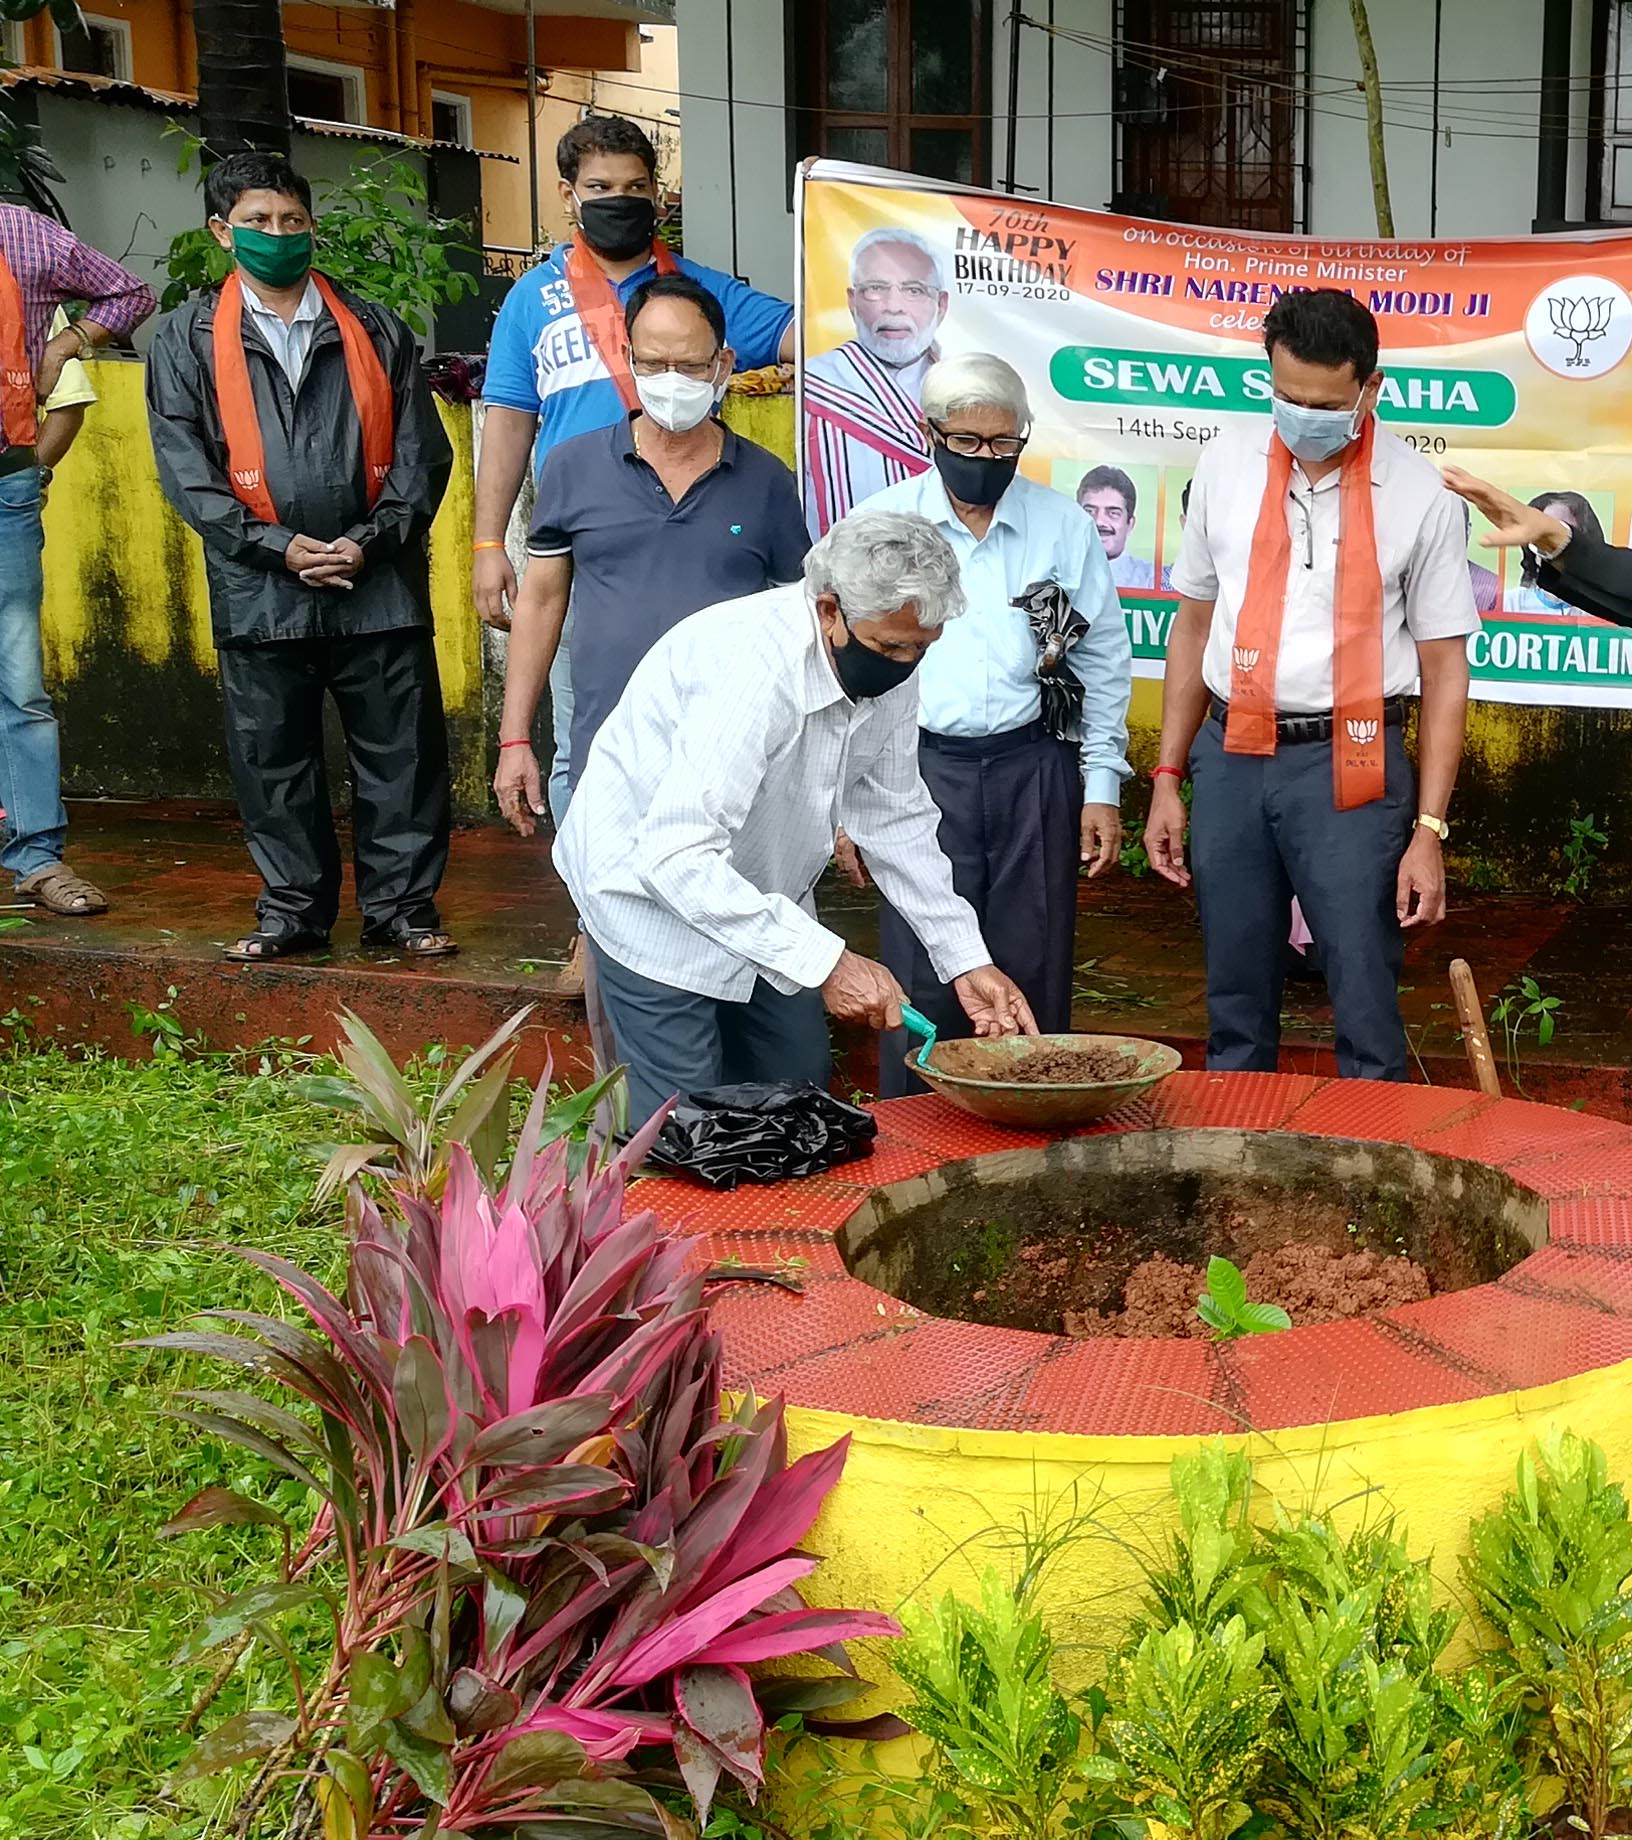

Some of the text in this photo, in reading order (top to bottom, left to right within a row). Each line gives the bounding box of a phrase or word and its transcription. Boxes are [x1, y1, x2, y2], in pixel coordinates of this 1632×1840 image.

[988, 208, 1049, 233] 70th
[955, 227, 1077, 260] HAPPY
[1123, 227, 1163, 244] on
[1444, 243, 1473, 267] of
[954, 254, 1073, 286] BIRTHDAY
[1184, 251, 1408, 282] Hon. Prime Minister
[956, 282, 1071, 301] 17-09-2020
[1095, 268, 1175, 298] SHRI
[1369, 289, 1454, 317] MODI
[1462, 293, 1492, 318] JI
[1083, 357, 1226, 397] SEWA
[1116, 417, 1165, 439] 14th
[1396, 434, 1447, 455] 020
